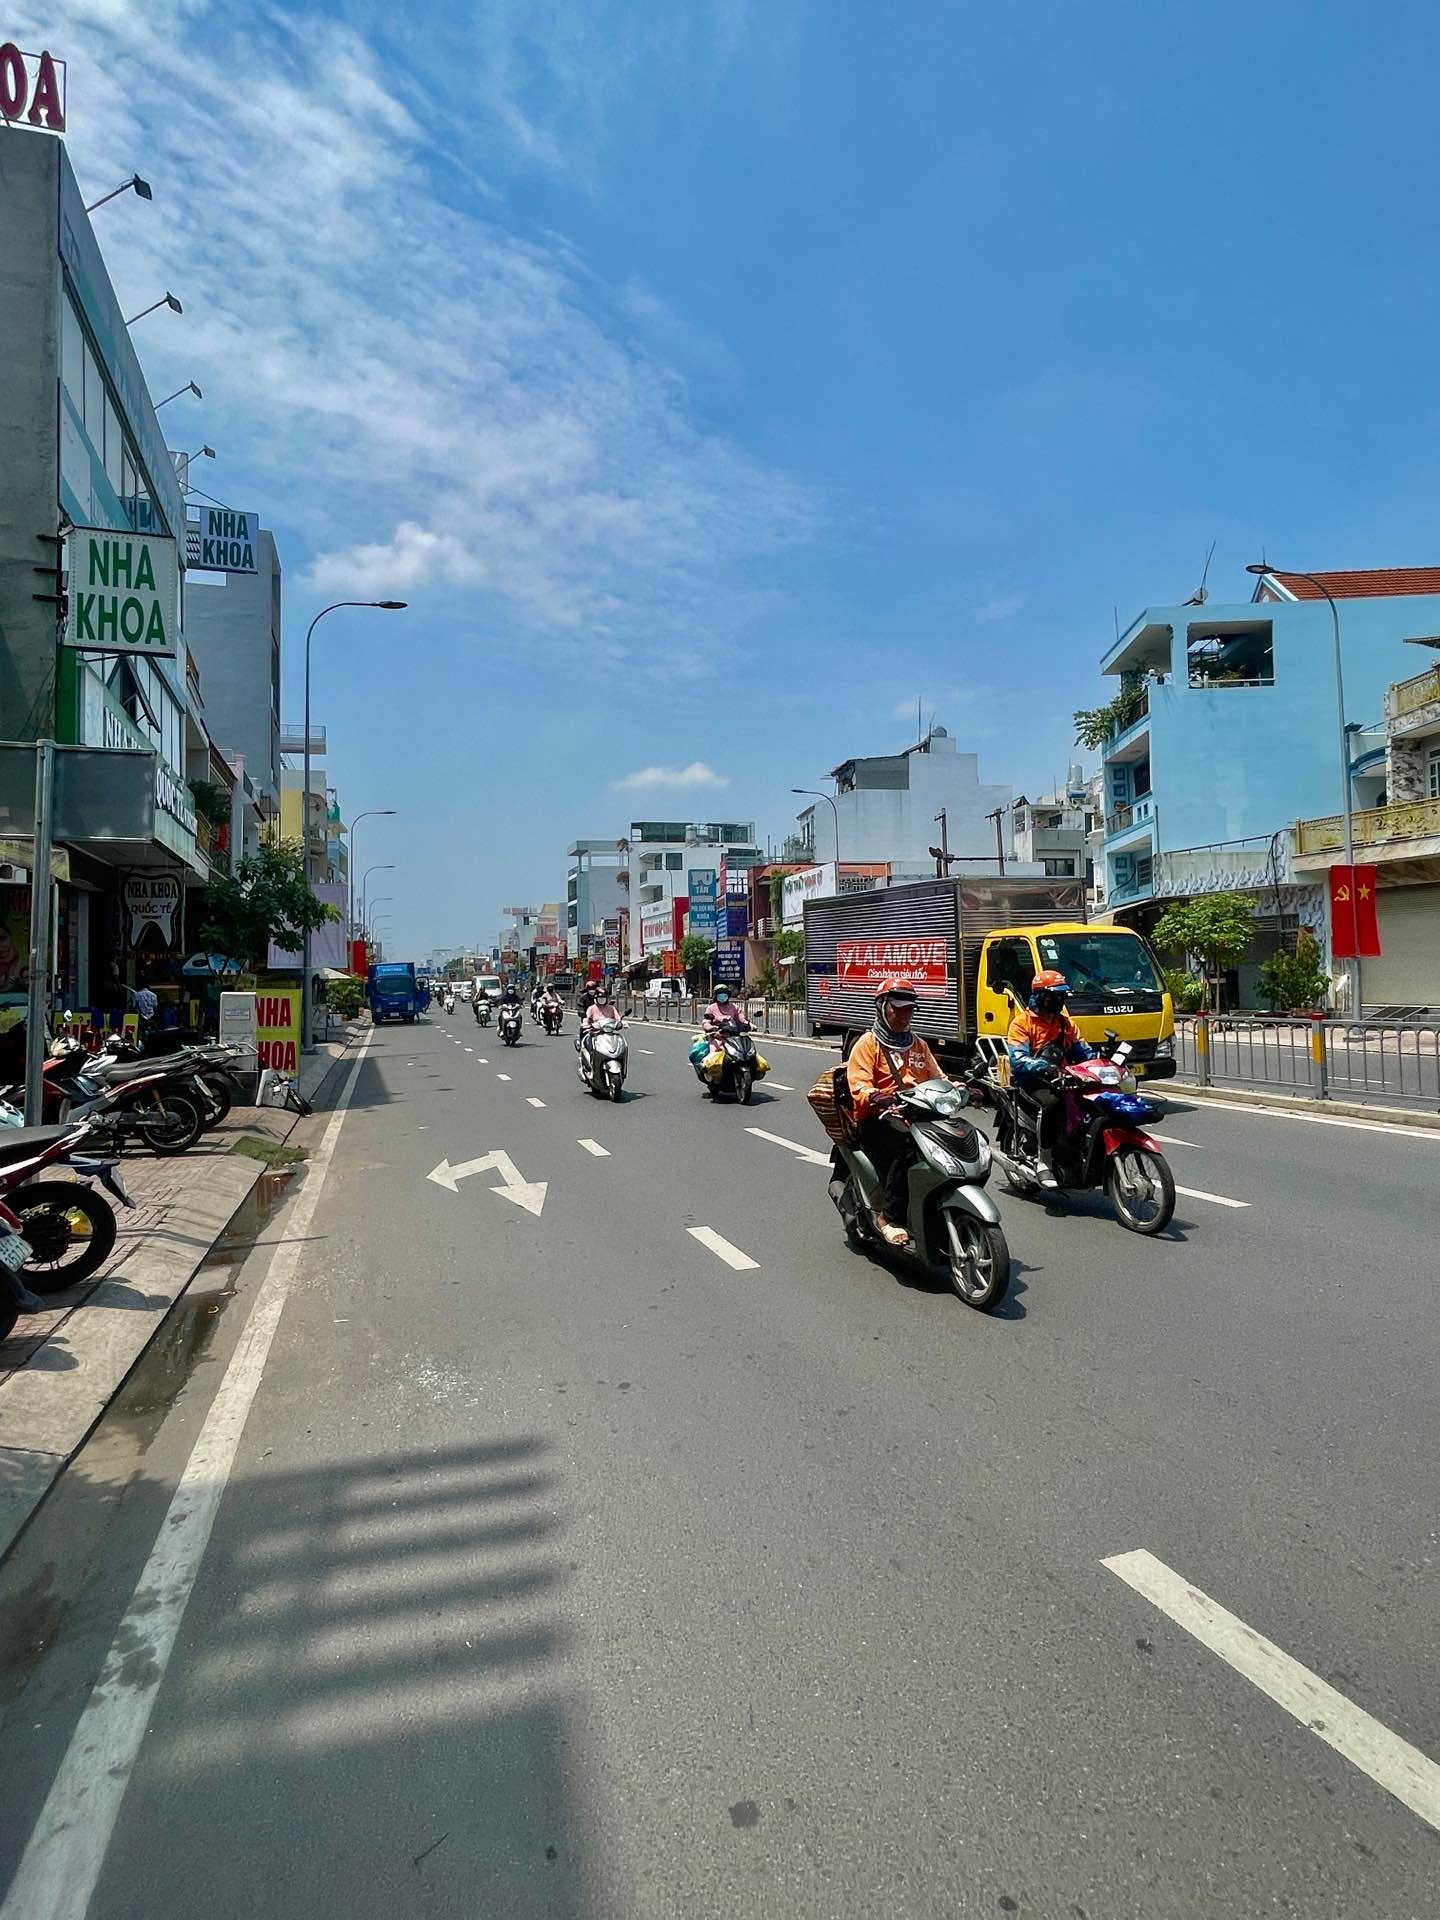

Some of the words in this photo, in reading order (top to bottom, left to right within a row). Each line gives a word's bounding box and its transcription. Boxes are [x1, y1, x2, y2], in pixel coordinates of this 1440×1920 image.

[209, 511, 249, 540] NHA
[89, 538, 156, 591] NHA
[203, 539, 254, 569] KHOA
[77, 592, 166, 646] KHOA
[127, 881, 149, 898] NHA
[150, 881, 177, 898] KHOA
[131, 901, 157, 914] QUỐC
[854, 942, 945, 966] LALAMOVE
[256, 997, 292, 1027] NHA
[1104, 1005, 1134, 1014] ISUZU
